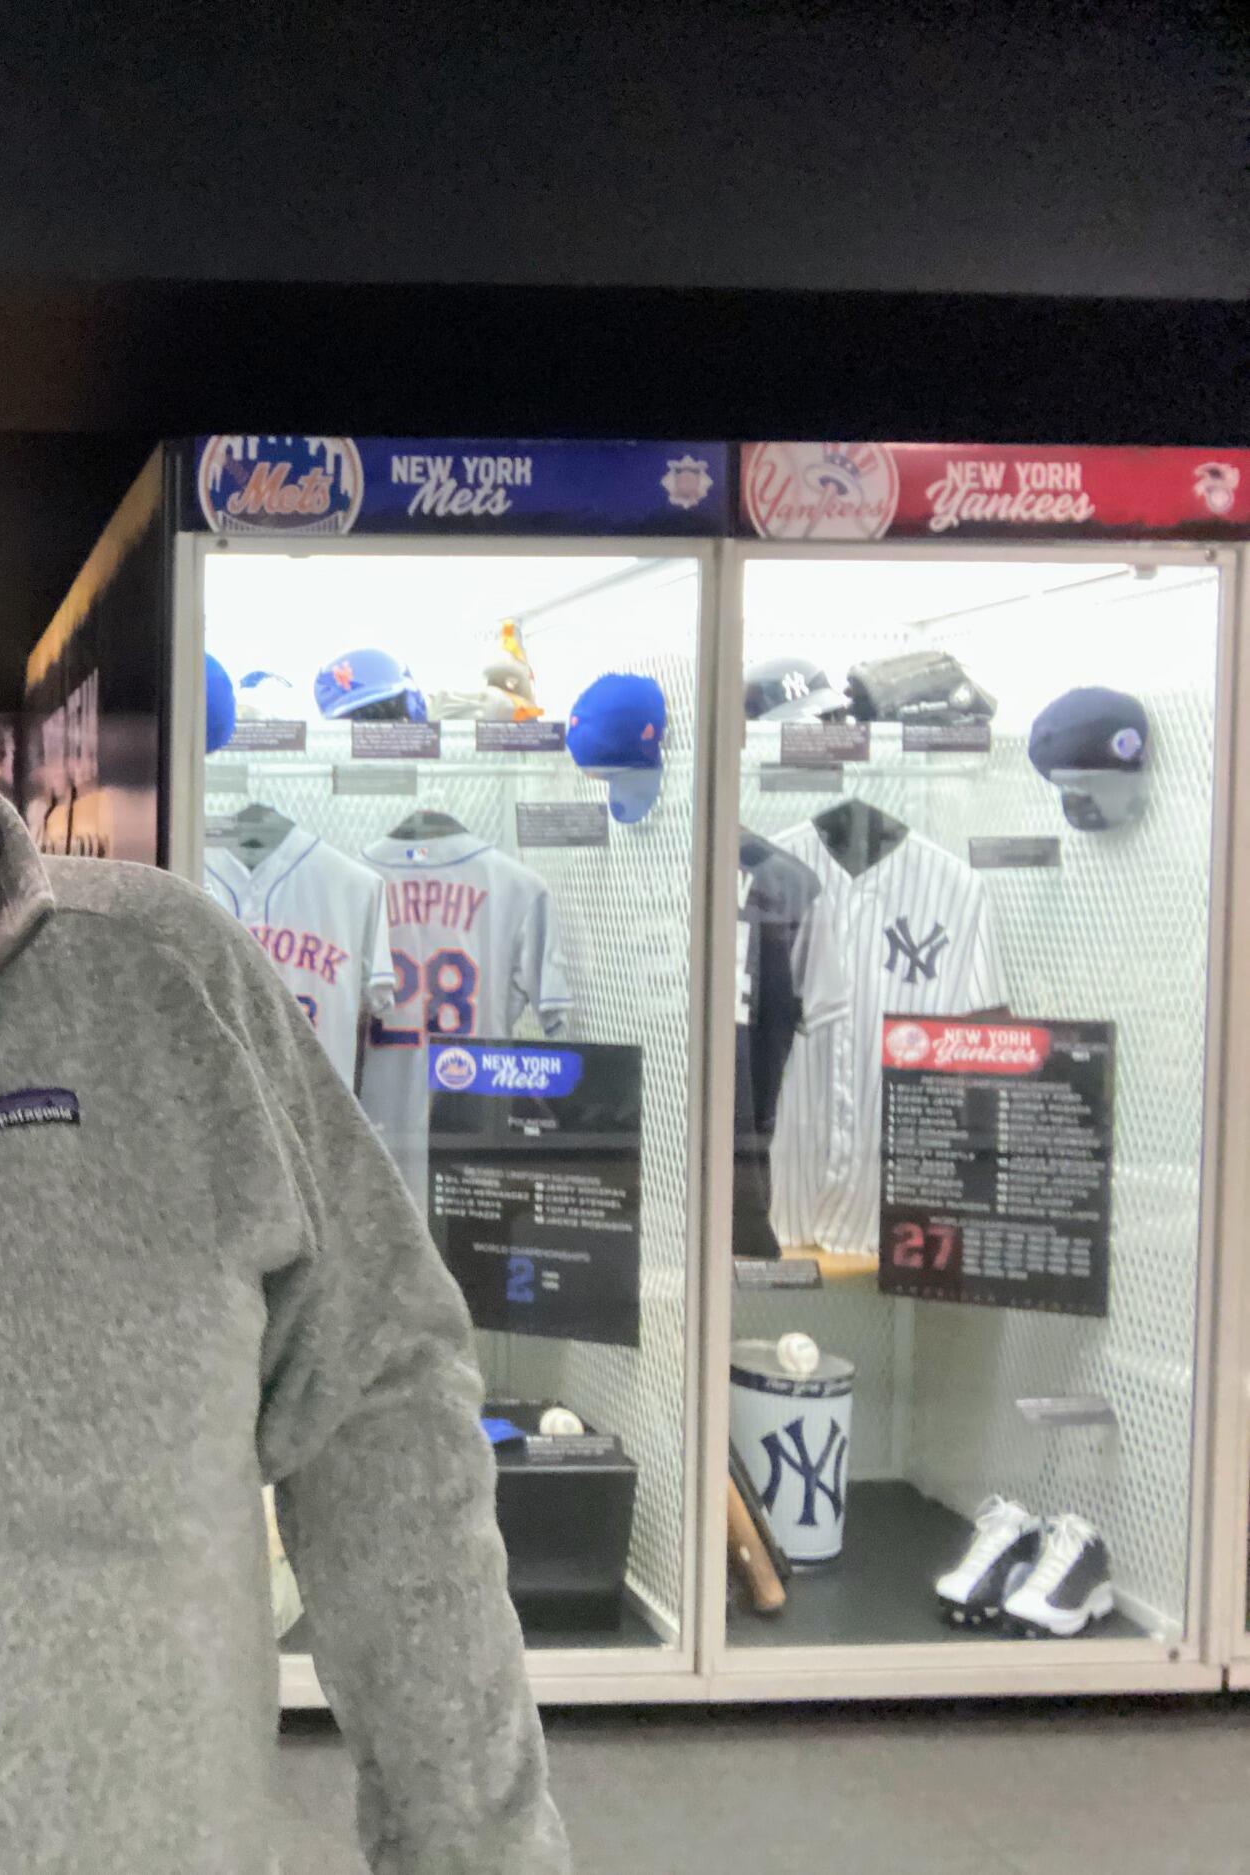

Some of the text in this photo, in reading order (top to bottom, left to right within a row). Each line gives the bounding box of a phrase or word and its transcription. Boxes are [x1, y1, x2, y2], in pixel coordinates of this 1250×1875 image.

[227, 461, 333, 515] Mets
[391, 455, 532, 486] NEW YORK
[946, 461, 1082, 491] NEW YORK
[407, 478, 513, 517] Mets
[925, 478, 1096, 532] Yankees
[386, 879, 489, 933] URPHY
[882, 916, 949, 984] NY
[932, 1036, 1040, 1066] Yankees
[944, 1028, 981, 1046] NEW
[989, 1030, 1031, 1050] YORK
[482, 1054, 515, 1071] NEW
[521, 1056, 561, 1074] YORK
[492, 1067, 550, 1089] Mets
[892, 1222, 957, 1270] 27
[506, 1256, 535, 1302] 2
[760, 1416, 847, 1526] NY
